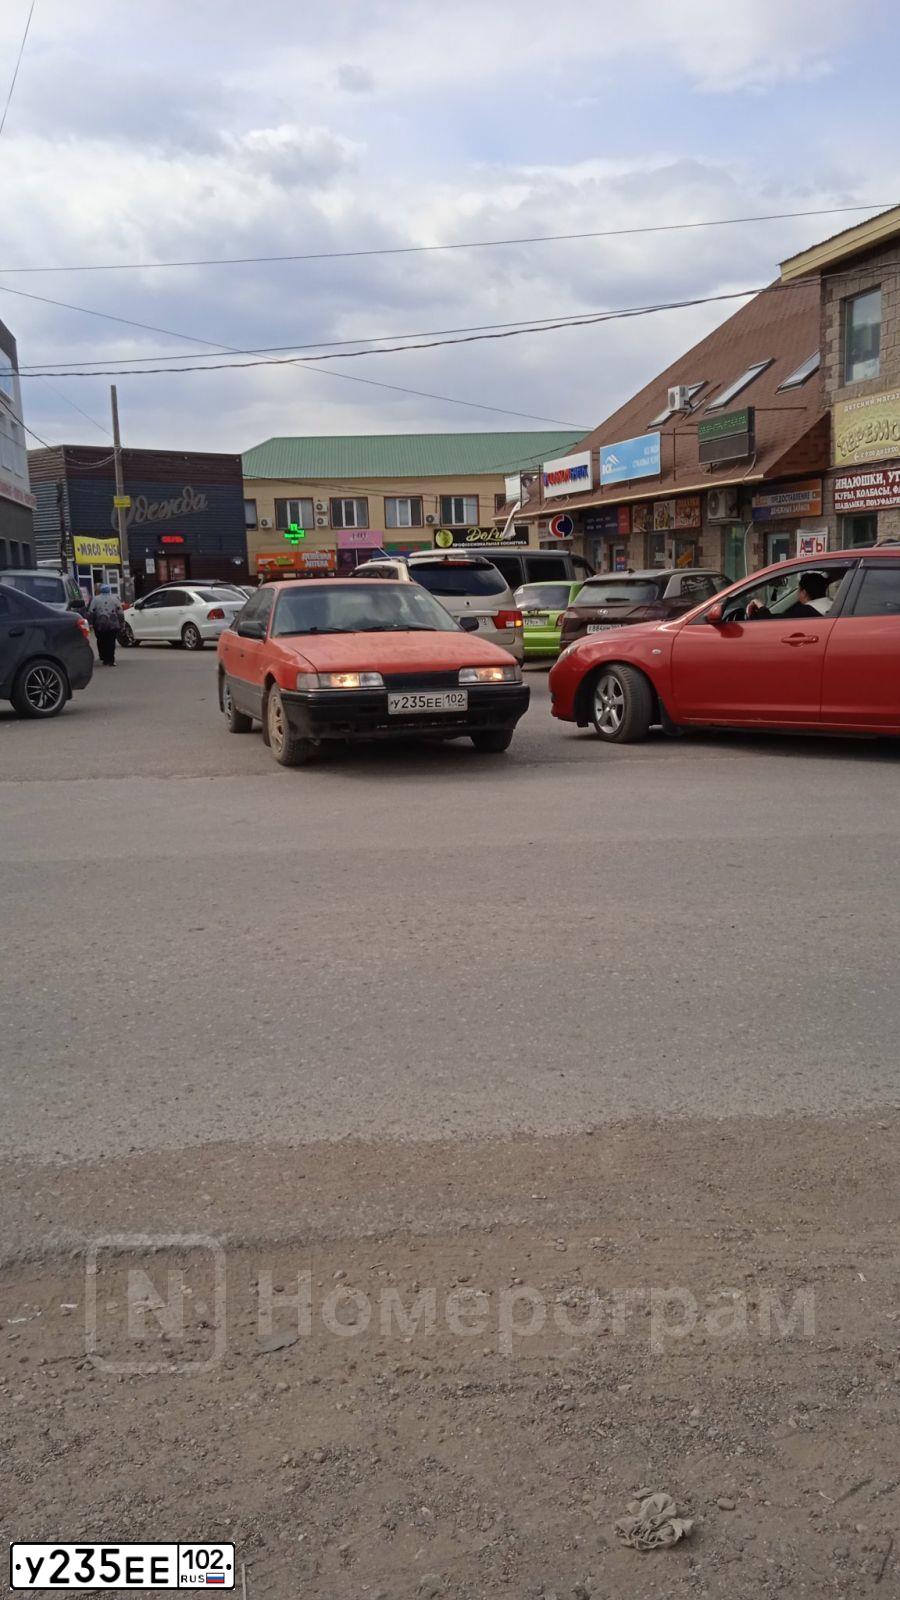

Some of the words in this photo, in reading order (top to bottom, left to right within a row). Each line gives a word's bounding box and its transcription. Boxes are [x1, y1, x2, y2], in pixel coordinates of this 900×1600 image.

[835, 473, 886, 489] ИНДЮШКИ,
[888, 470, 900, 483] УТ
[834, 490, 856, 500] КУРЫ,
[856, 486, 892, 498] КОЛБАСЫ,
[80, 543, 101, 556] МЯСО
[393, 695, 442, 709] У235ЕЕ
[445, 693, 464, 704] 102
